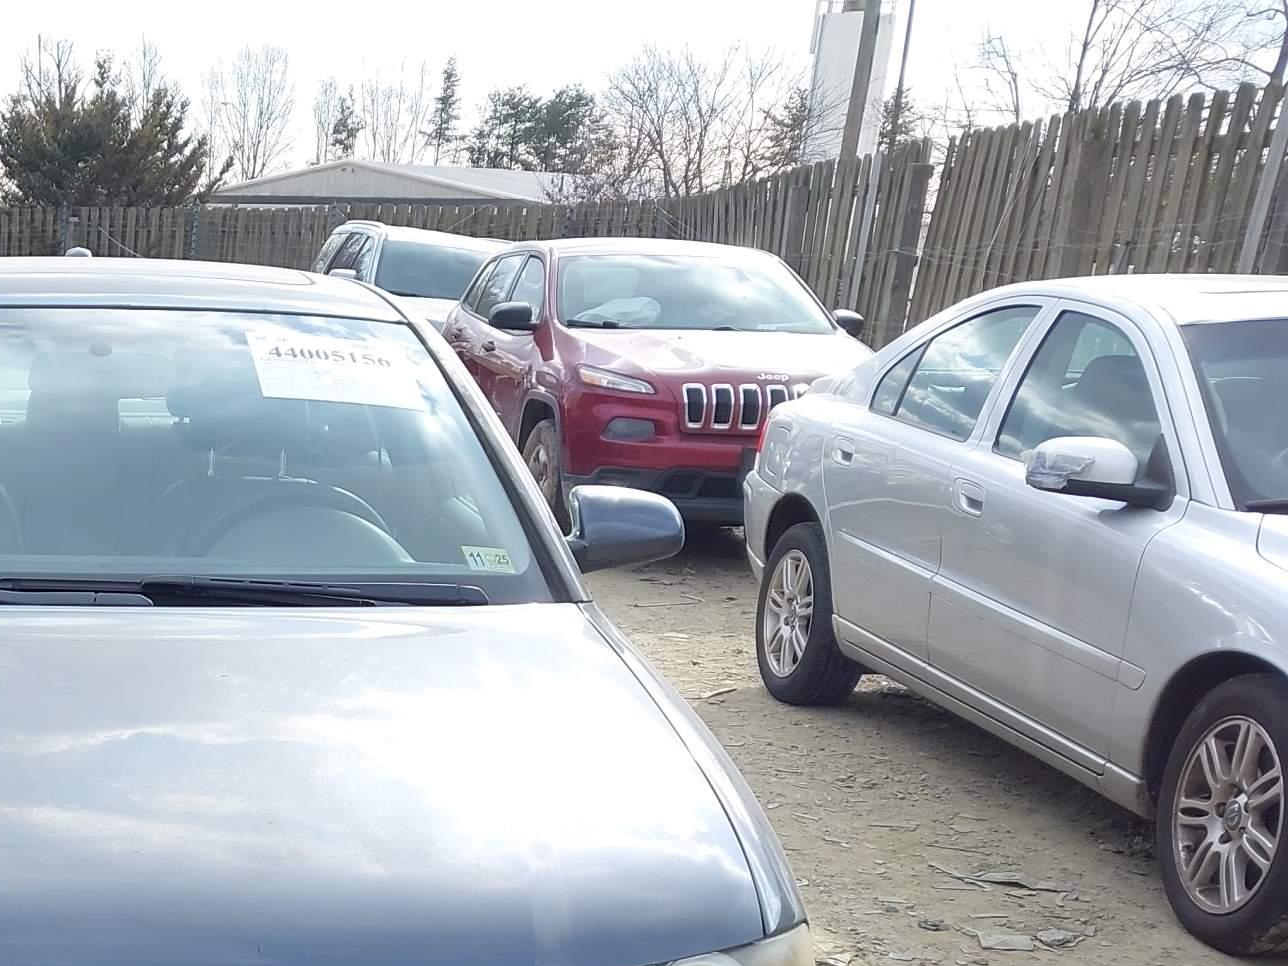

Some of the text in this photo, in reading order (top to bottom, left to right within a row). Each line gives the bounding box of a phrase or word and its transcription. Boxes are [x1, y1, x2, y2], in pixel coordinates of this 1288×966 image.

[268, 346, 391, 367] 44005156
[757, 372, 789, 381] Jeep
[469, 551, 510, 566] 11 25
